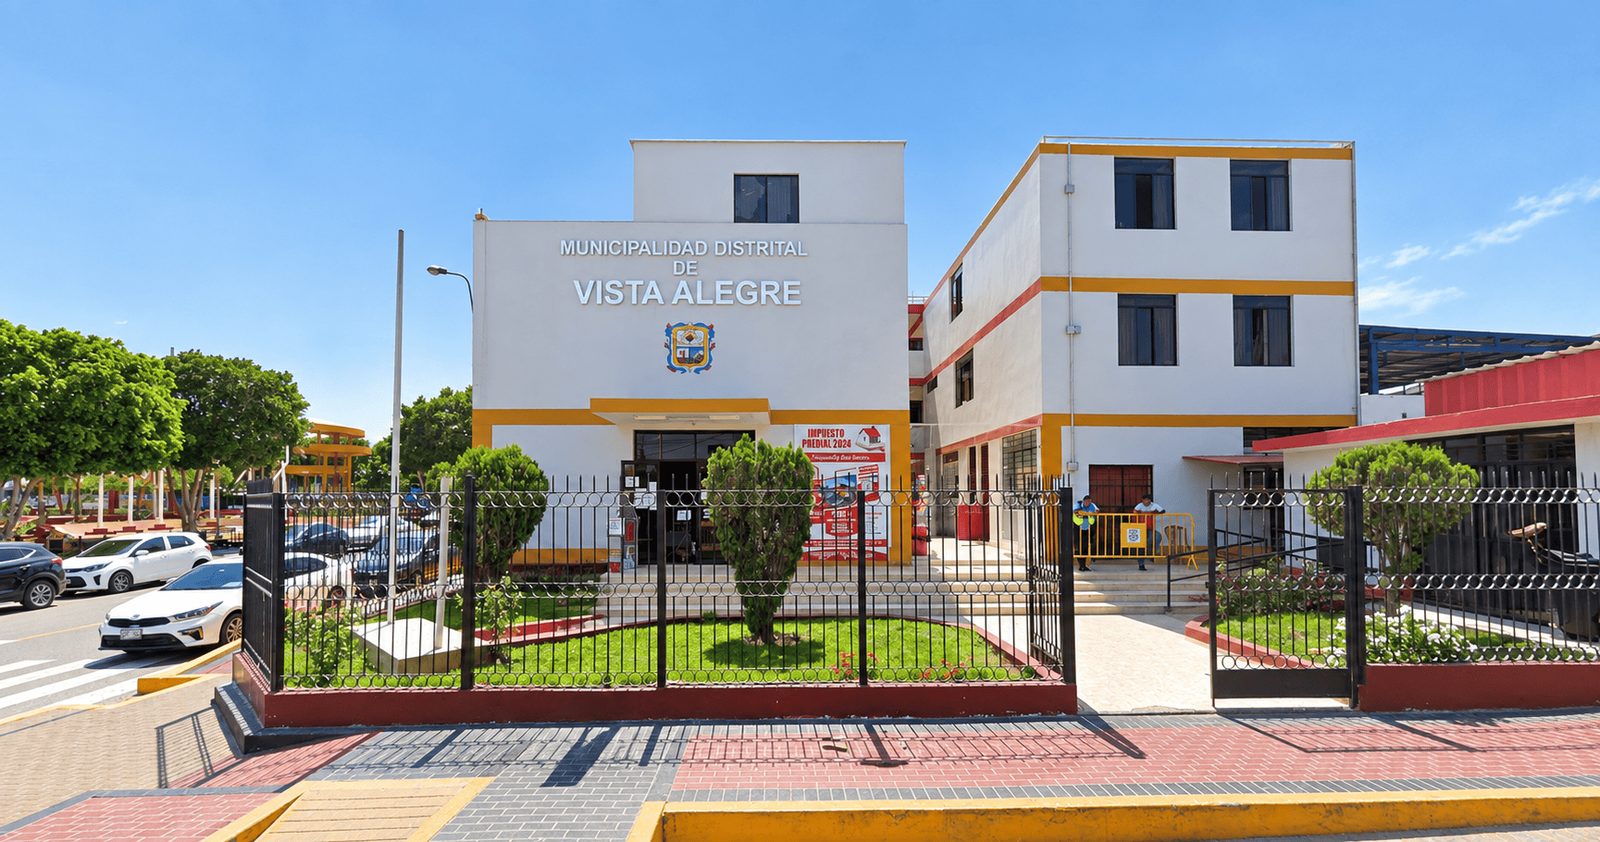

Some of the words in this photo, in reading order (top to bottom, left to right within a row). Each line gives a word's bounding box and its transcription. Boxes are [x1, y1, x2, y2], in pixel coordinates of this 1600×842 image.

[560, 240, 708, 256] MUNICIPALIDAD
[714, 240, 808, 256] DISTRITAL
[673, 260, 698, 276] DE
[573, 279, 665, 305] VISTA
[671, 279, 802, 306] ALEGRE
[807, 428, 845, 438] IMPUESTO
[802, 439, 831, 449] PREDIAL
[833, 439, 852, 449] 2024
